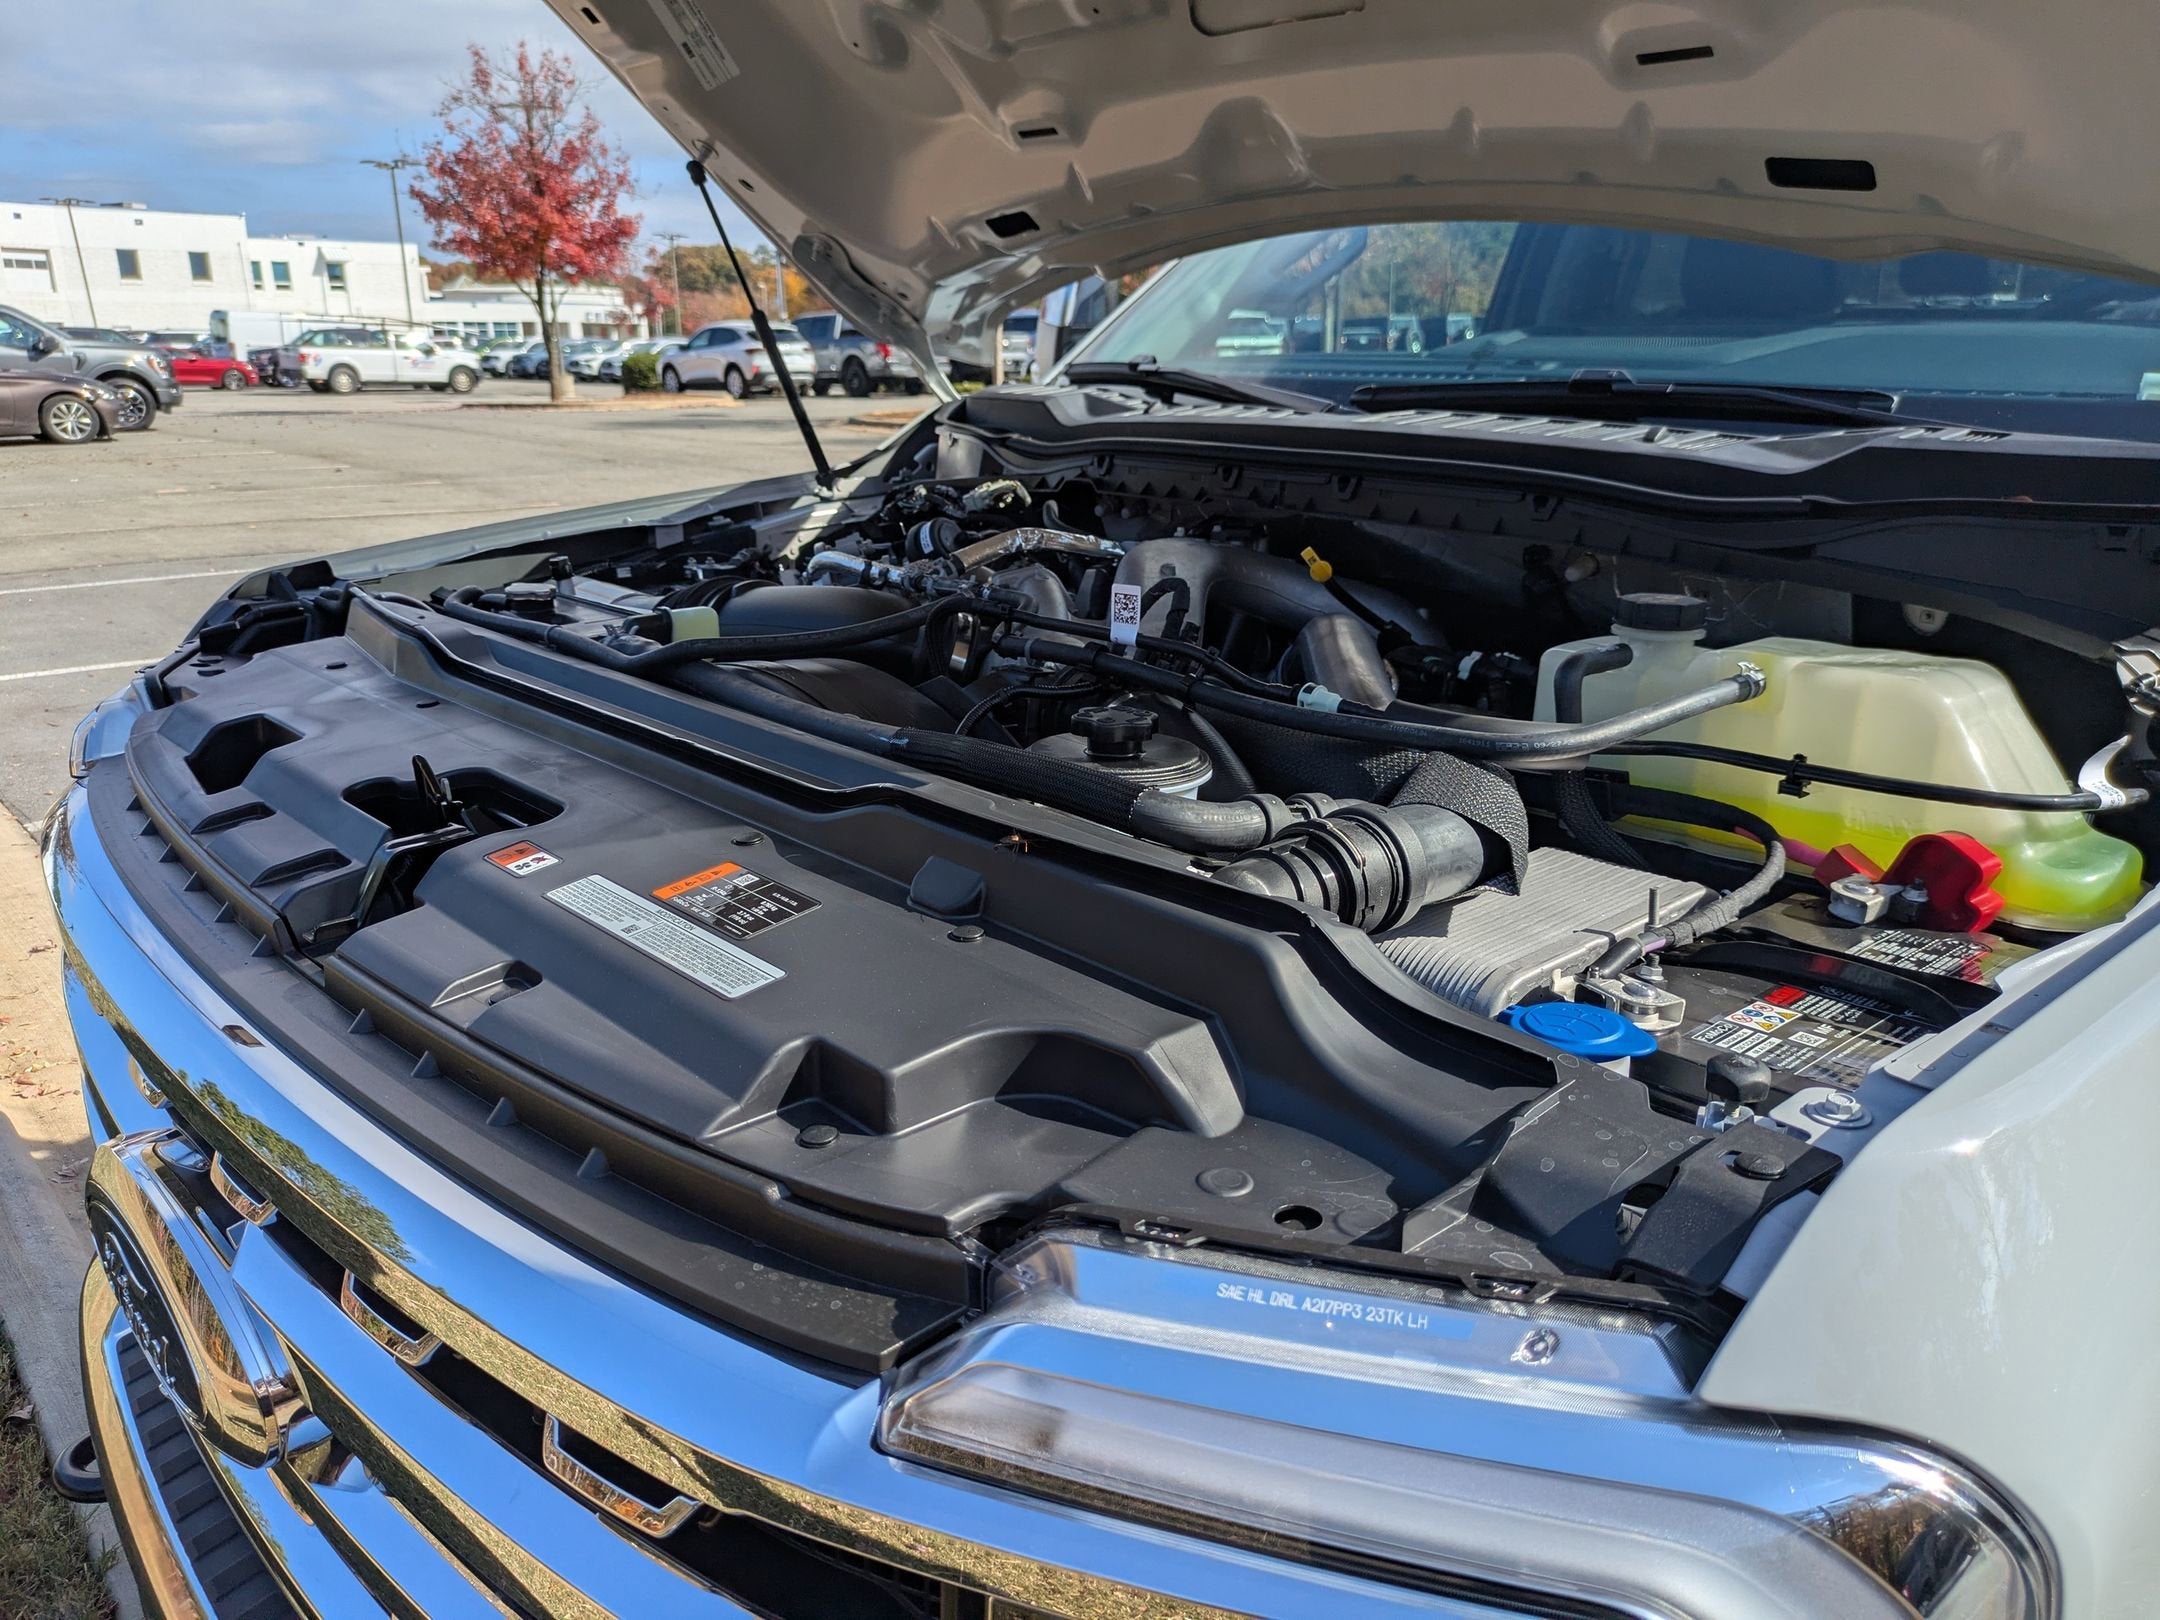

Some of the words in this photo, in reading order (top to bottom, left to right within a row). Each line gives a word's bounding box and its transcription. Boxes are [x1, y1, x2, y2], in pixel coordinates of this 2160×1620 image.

[656, 909, 697, 932] MODIFICATION
[1696, 1022, 1736, 1042] FoMoCo
[1215, 1282, 1247, 1302] SAE
[1247, 1288, 1266, 1305] HL
[1270, 1290, 1297, 1310] DRL
[1365, 1306, 1404, 1327] 23TK
[1407, 1312, 1429, 1330] LH
